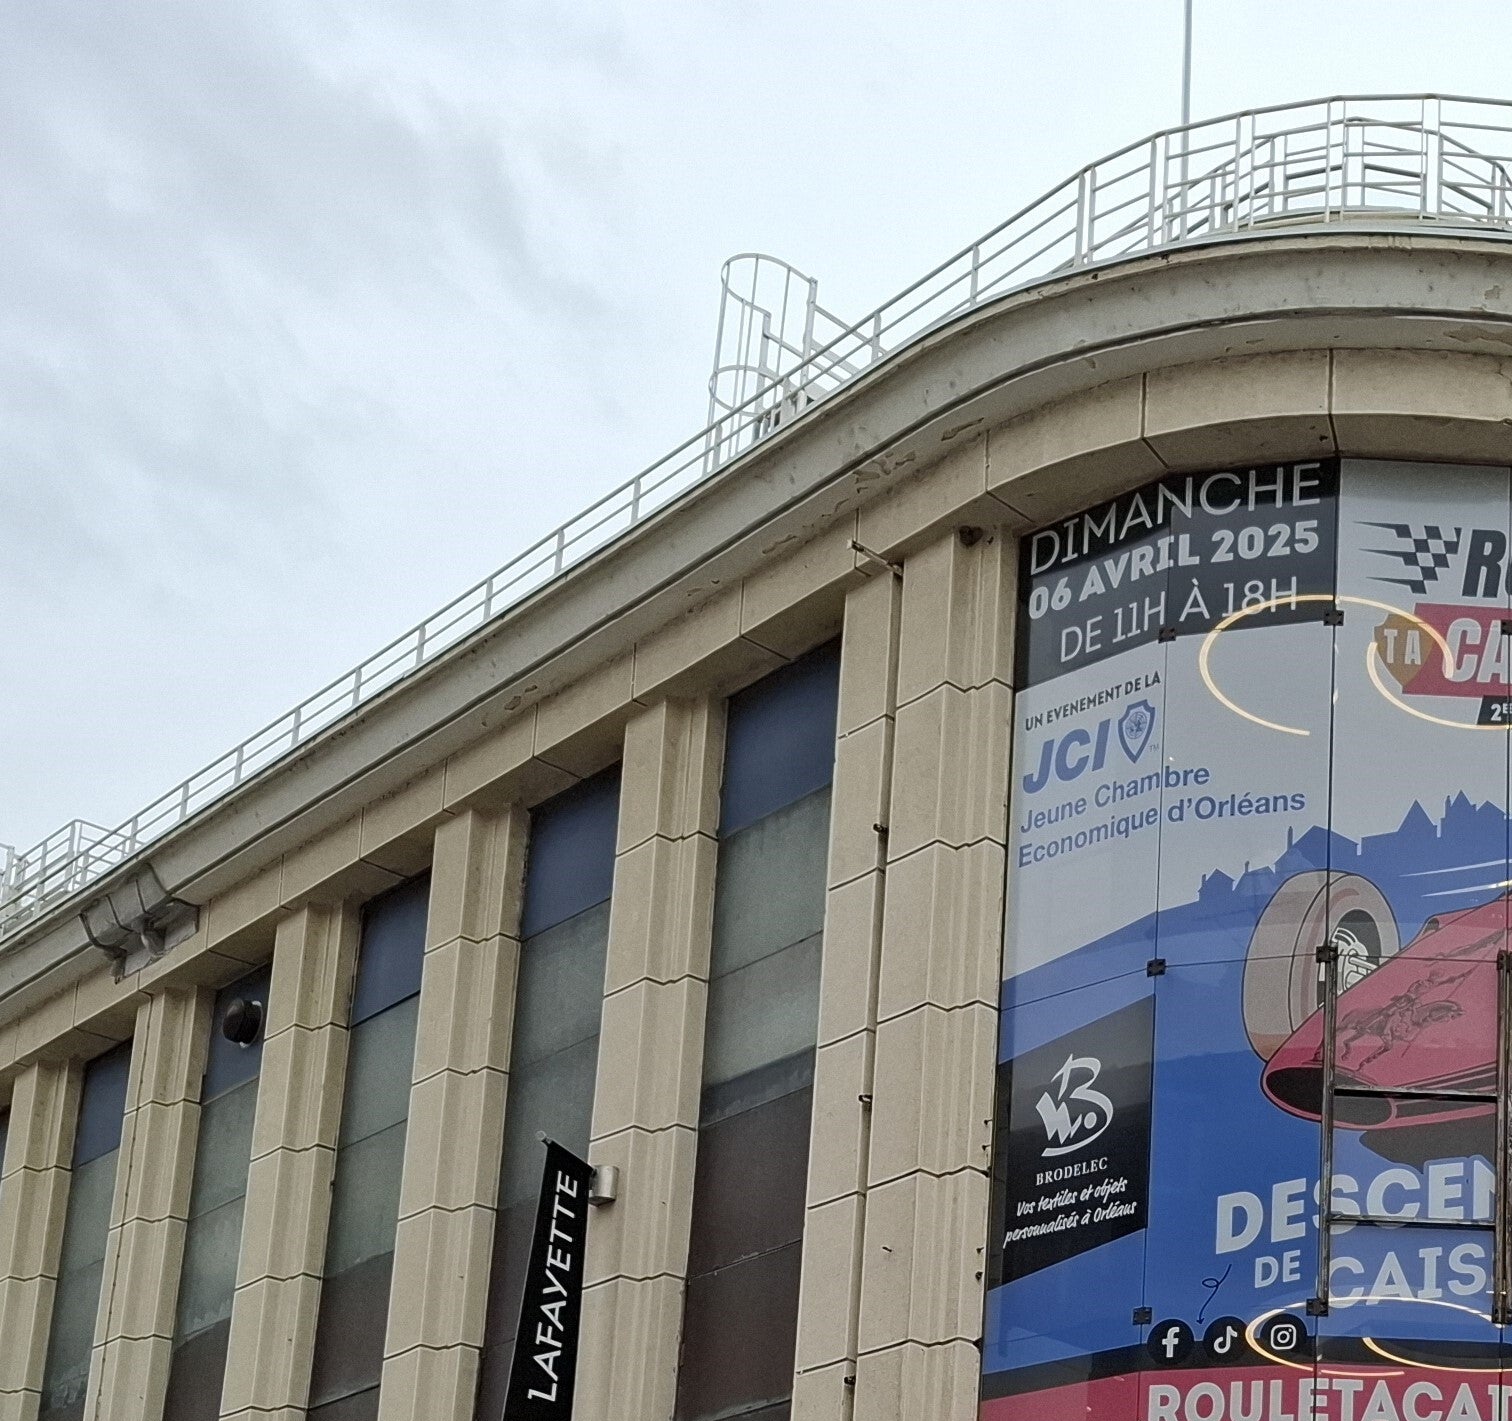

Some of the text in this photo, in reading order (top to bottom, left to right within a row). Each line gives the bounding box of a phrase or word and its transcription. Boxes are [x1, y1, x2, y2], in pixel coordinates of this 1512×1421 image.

[1029, 462, 1322, 579] DIMANCHE
[1027, 519, 1320, 620] 06 AVRIL 2025
[1059, 575, 1298, 665] DE 11H À 18H
[1383, 627, 1422, 666] TA
[1026, 671, 1160, 731] UN EVENEMENT DE LA
[1022, 718, 1111, 794] JCI
[1020, 766, 1210, 834] Jeune Chambre
[1018, 806, 1159, 868] Economique
[1017, 1176, 1128, 1219] Vos textiles et objets
[1035, 1157, 1108, 1186] BRODELEC
[1002, 1200, 1137, 1250] personnalisés à Orléans
[527, 1169, 578, 1402] LAFAYETTE
[1254, 1249, 1302, 1289] DE
